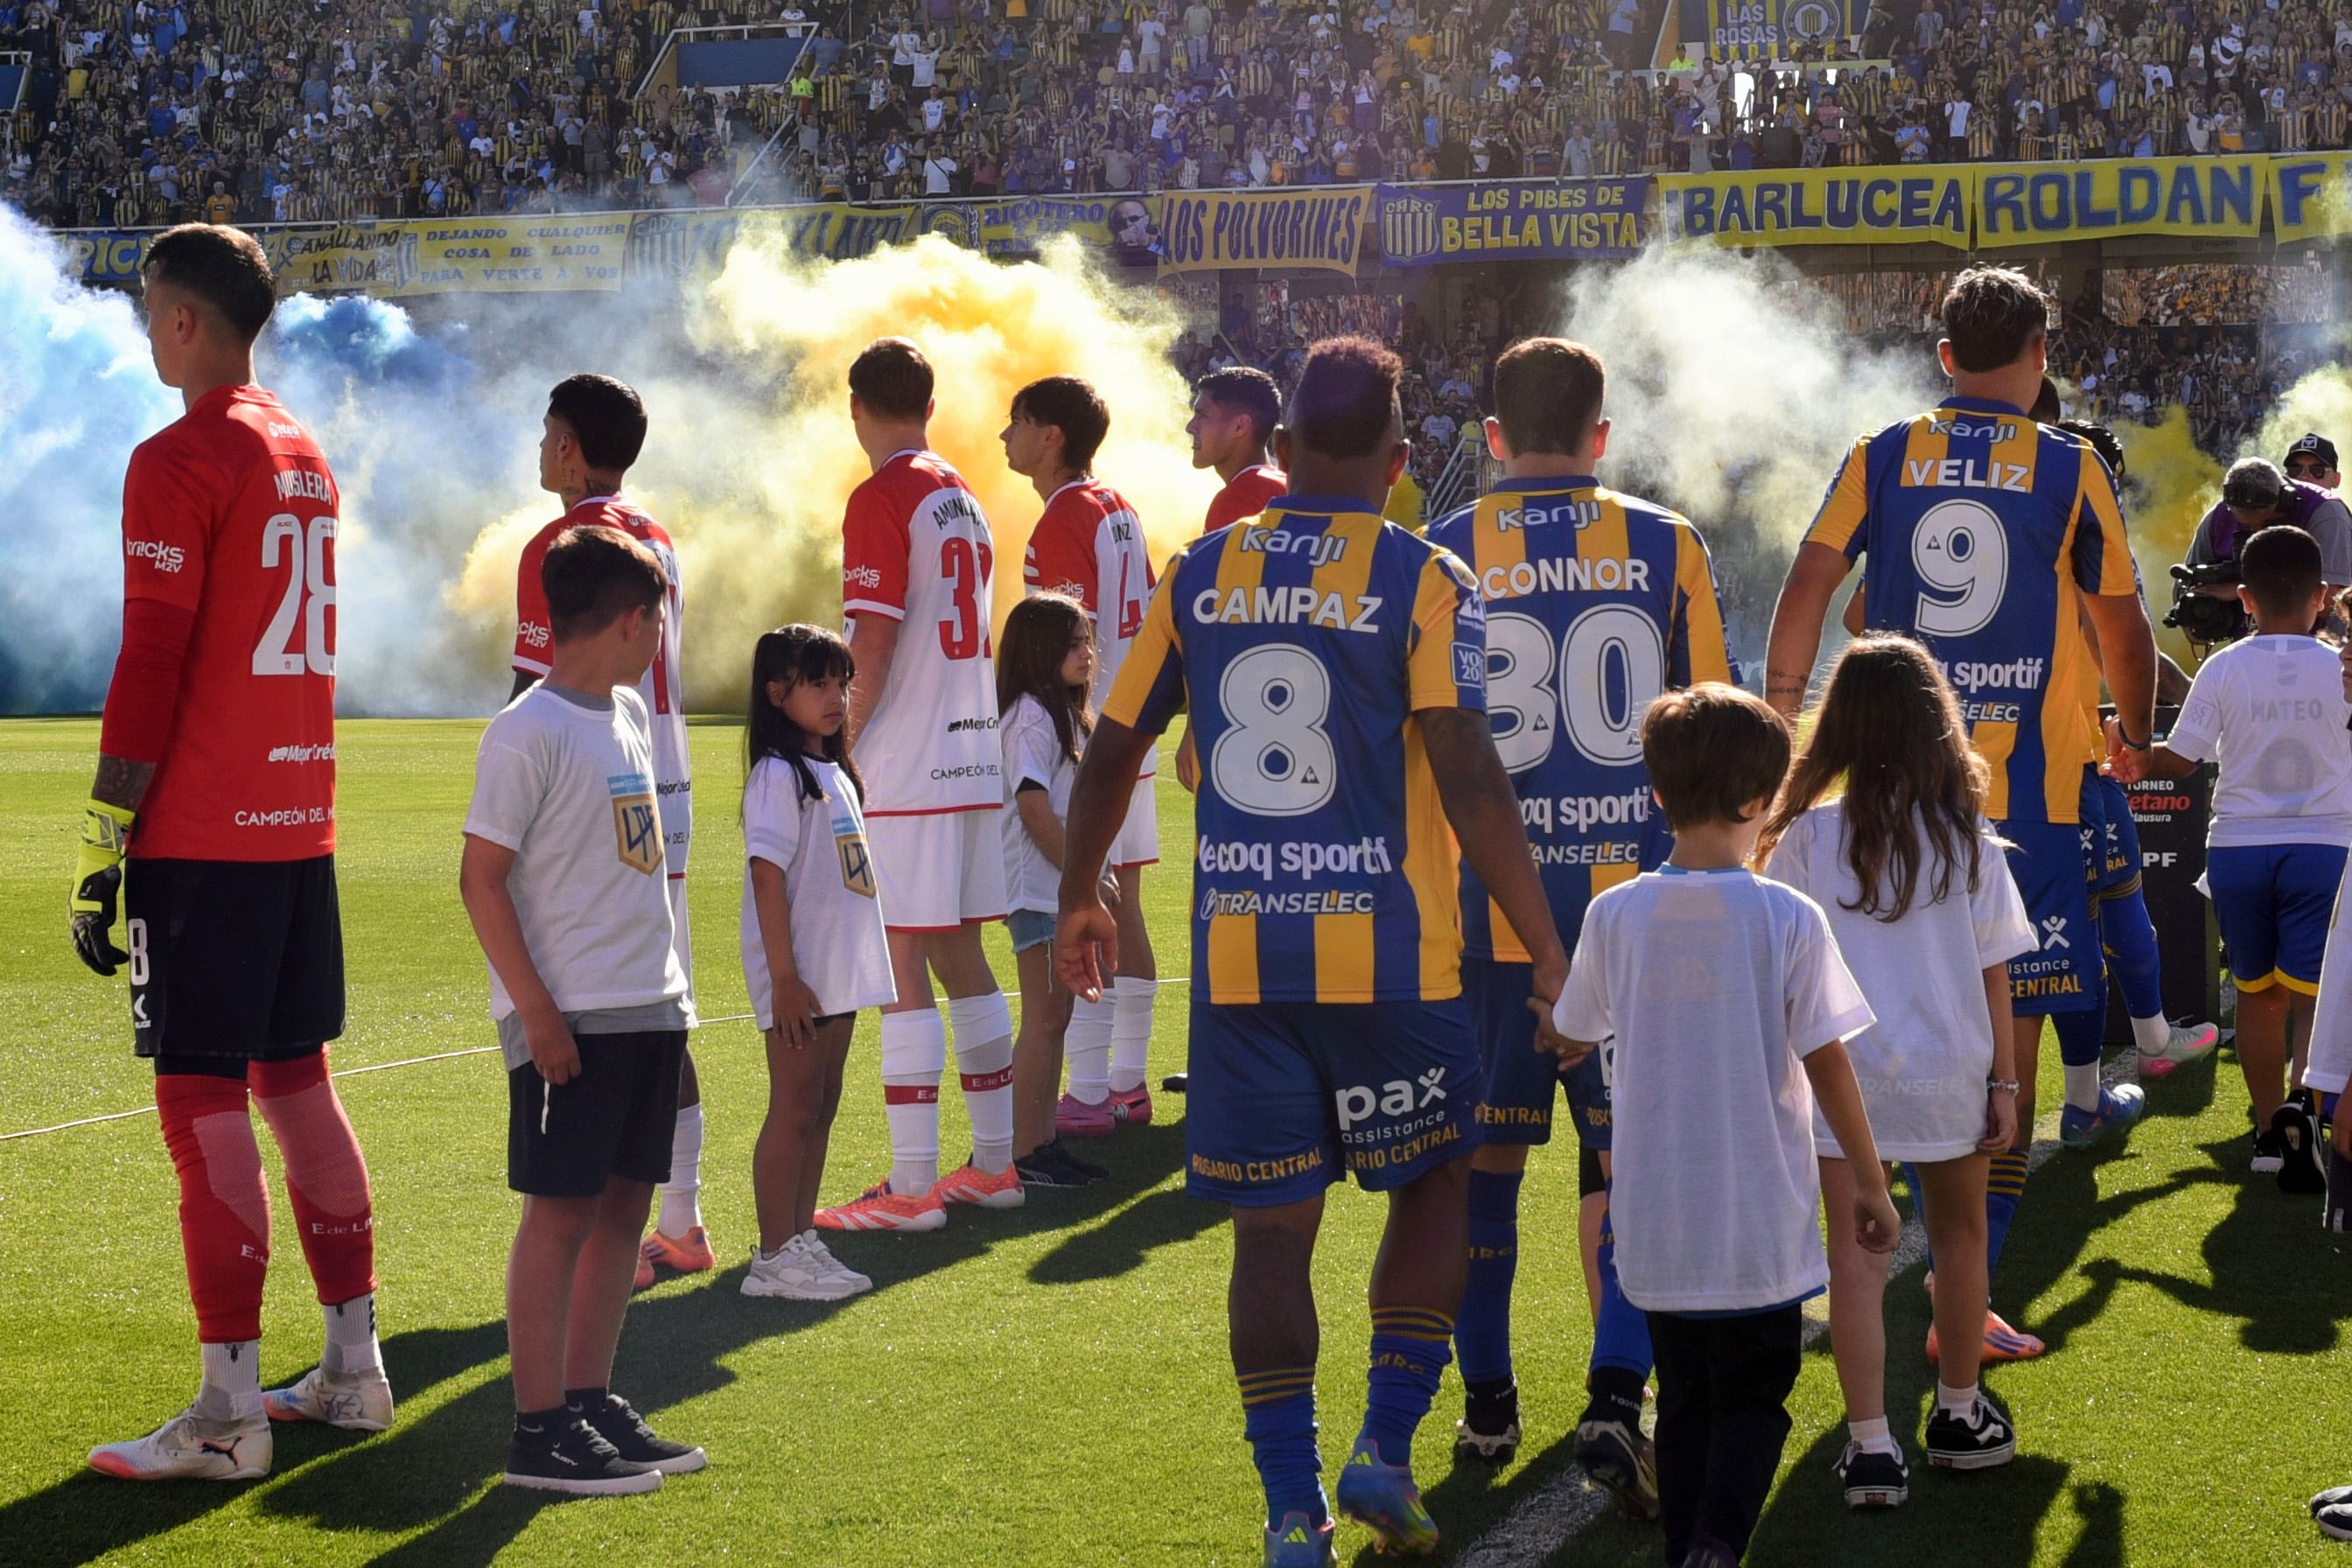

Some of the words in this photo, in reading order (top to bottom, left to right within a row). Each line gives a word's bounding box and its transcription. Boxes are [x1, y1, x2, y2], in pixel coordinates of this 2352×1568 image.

[1726, 4, 1764, 24] LAS
[1714, 24, 1778, 45] ROSAS
[1467, 187, 1508, 211] LOS
[1519, 189, 1586, 209] PIBES
[1596, 186, 1626, 206] DE
[1983, 164, 2253, 233] ROLDAN
[984, 200, 1105, 226] RICOTERO
[425, 228, 508, 242] DEJANDO
[527, 224, 626, 238] CUALQUIER
[1163, 198, 1208, 265] LOS
[1213, 195, 1362, 264] POLVORINES
[1441, 214, 1542, 252] BELLA
[1549, 212, 1640, 248] VISTA
[444, 248, 491, 259] COSA
[509, 247, 533, 258] DE
[551, 244, 600, 256] LADO
[313, 259, 332, 284] LA
[420, 268, 464, 283] PARA
[483, 268, 542, 281] VERTE
[557, 266, 570, 280] A
[584, 266, 618, 280] VOS
[273, 469, 332, 506] MUSLERA
[1908, 458, 2030, 493] VELIZ
[154, 559, 183, 573] M2V
[1482, 557, 1650, 599] CONNOR
[1911, 498, 2009, 638] 9
[252, 513, 337, 676] 28
[1193, 587, 1382, 633] CAMPAZ
[525, 636, 548, 648] M2V
[1485, 603, 1665, 774] 30
[1953, 658, 2044, 694] sportif
[1960, 704, 2020, 722] SELEC
[2250, 699, 2322, 722] MATEO
[1210, 643, 1337, 816] 8
[1559, 786, 1650, 833] sporti
[2127, 793, 2191, 811] etano
[234, 807, 306, 826] CAMPEÓN
[310, 807, 326, 822] DEL
[2133, 813, 2172, 822] lausura
[1531, 844, 1640, 864] ANSELEC
[2143, 852, 2178, 867] PF
[1217, 892, 1374, 914] TRANSELEC
[2009, 959, 2070, 975] istance
[1341, 1110, 1445, 1144] assistance
[1390, 1123, 1462, 1165] CENTRAL
[1246, 1147, 1324, 1181] CENTRAL
